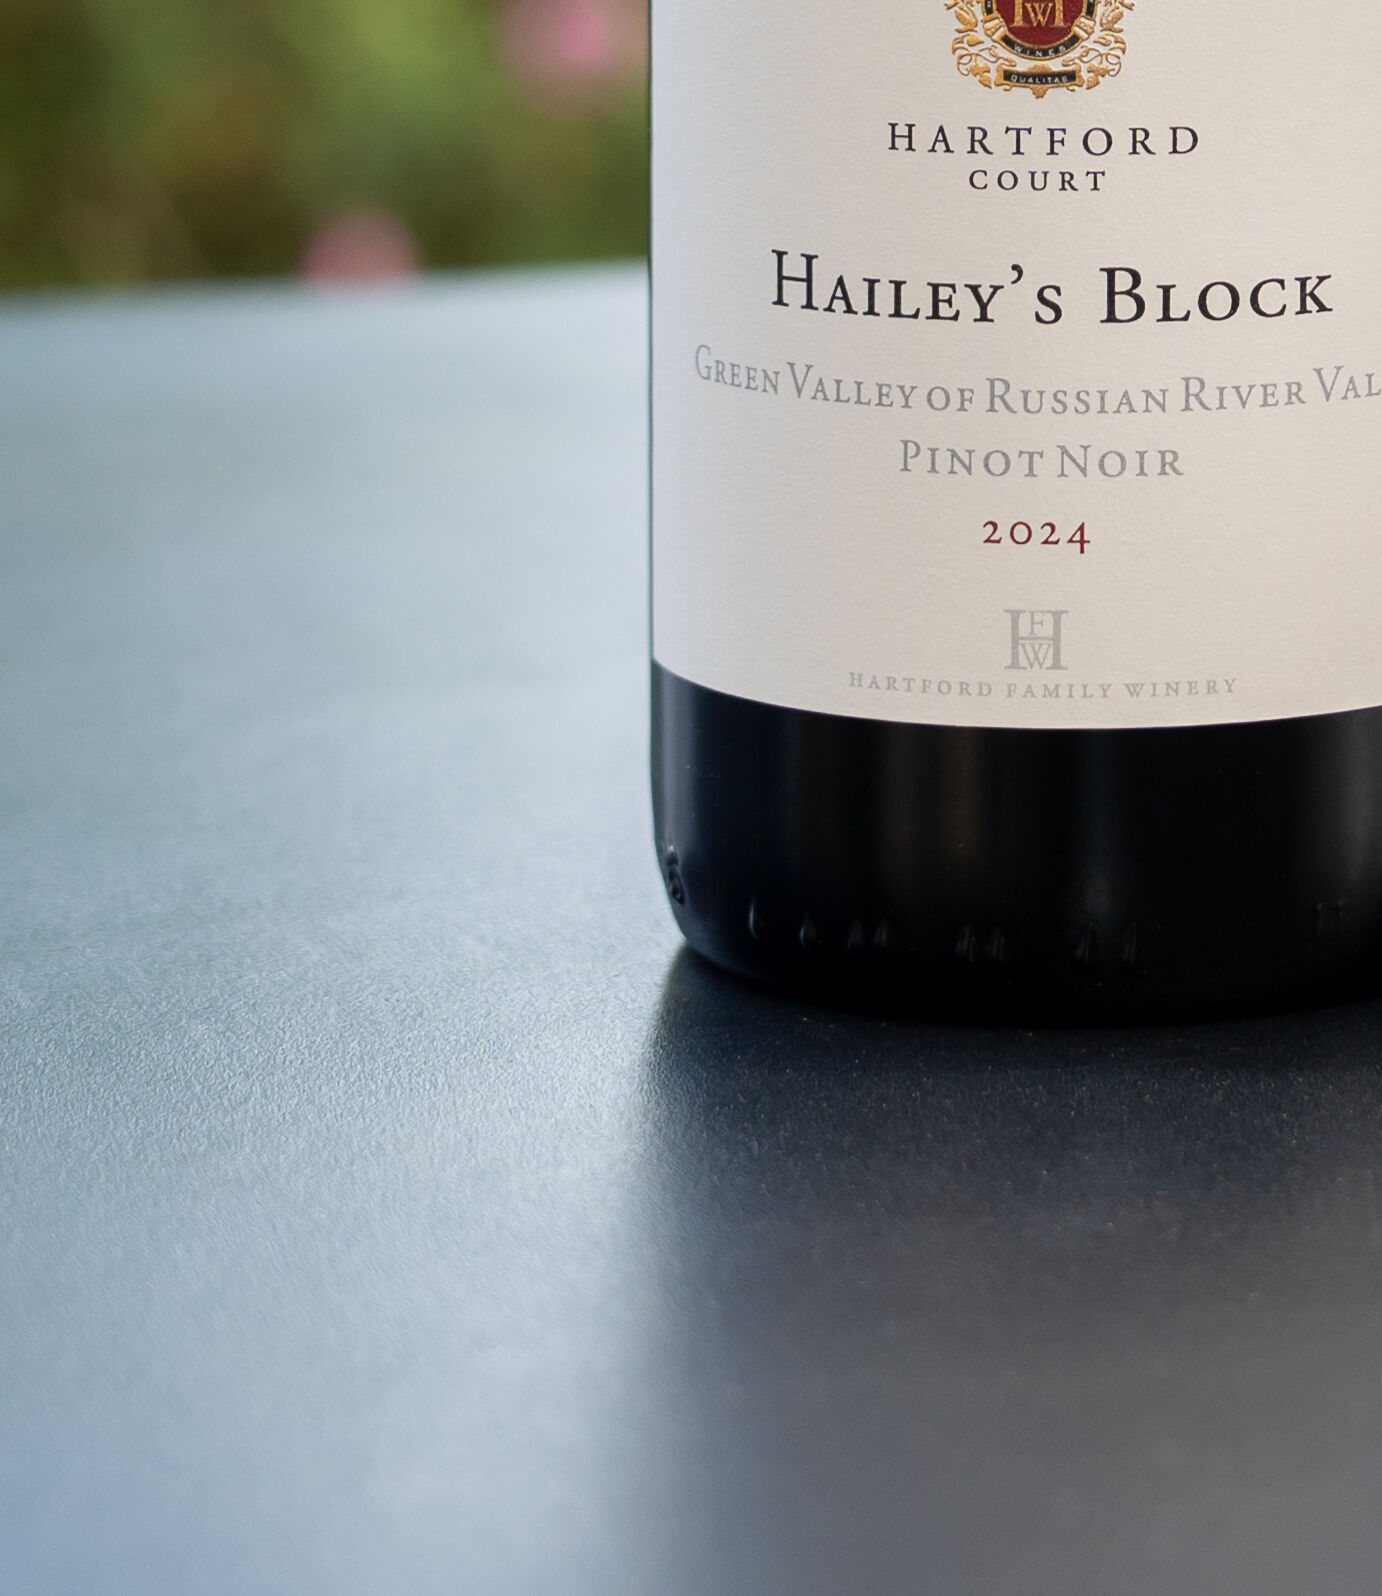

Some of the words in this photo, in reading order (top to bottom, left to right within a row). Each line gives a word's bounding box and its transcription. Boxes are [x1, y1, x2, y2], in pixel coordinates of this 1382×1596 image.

[1013, 44, 1067, 58] WINES
[1009, 72, 1070, 86] QUALITAS
[887, 122, 1199, 157] HARTFORD
[968, 169, 1106, 192] COURT
[982, 520, 1091, 555] 2024
[848, 671, 993, 697] HARTFORD
[1005, 682, 1112, 700] FAMILY
[1123, 677, 1237, 699] WINERY
